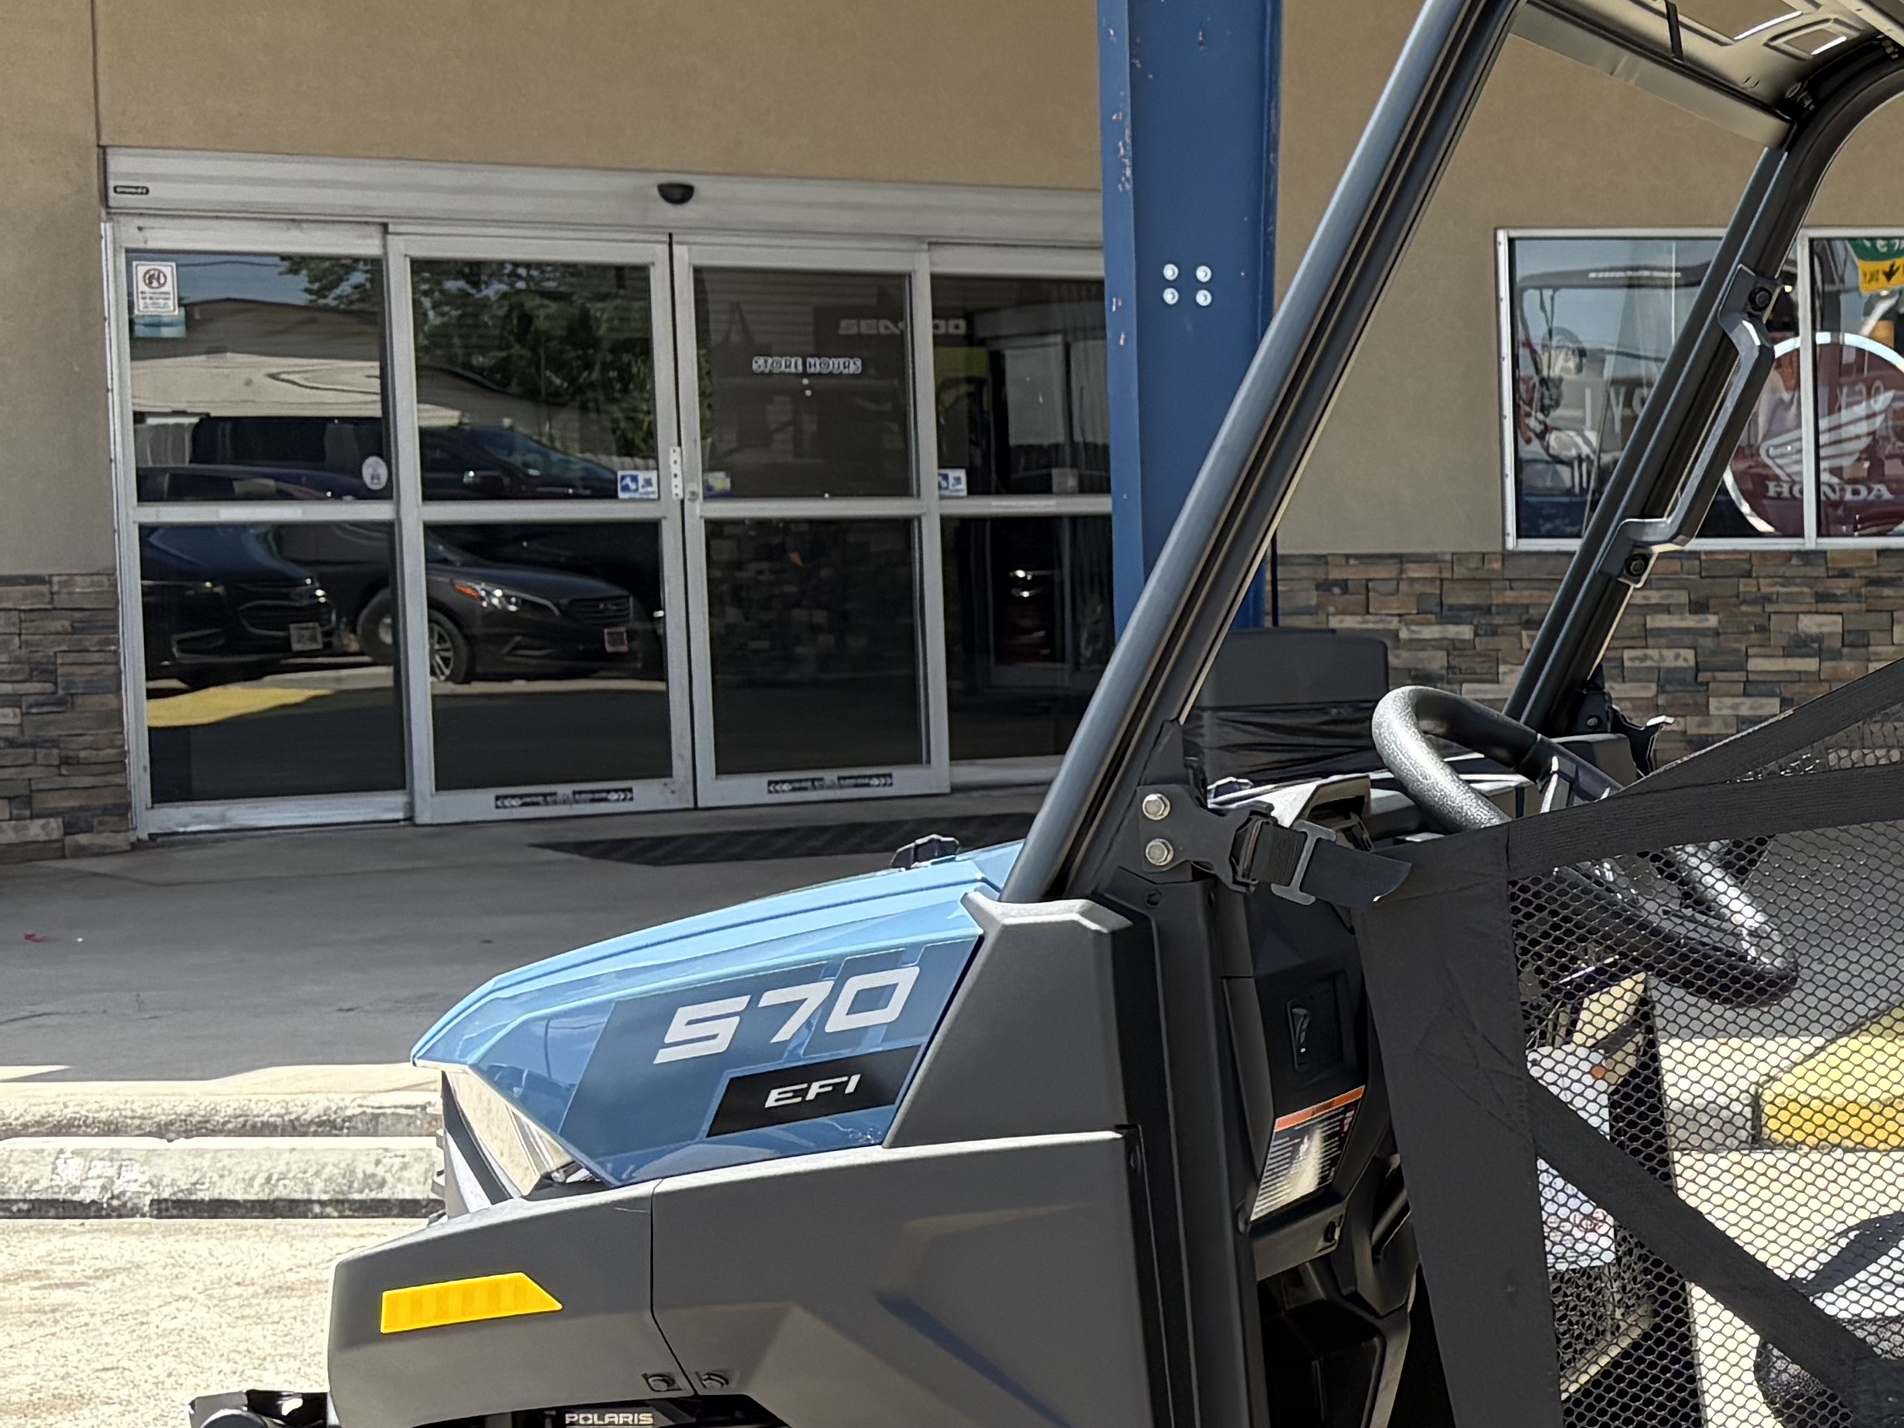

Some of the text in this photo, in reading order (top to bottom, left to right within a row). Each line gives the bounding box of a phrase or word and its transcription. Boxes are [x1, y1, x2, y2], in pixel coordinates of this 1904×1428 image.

[653, 966, 920, 1064] 570
[764, 1074, 861, 1108] EFI
[565, 1413, 654, 1425] POLARIS
